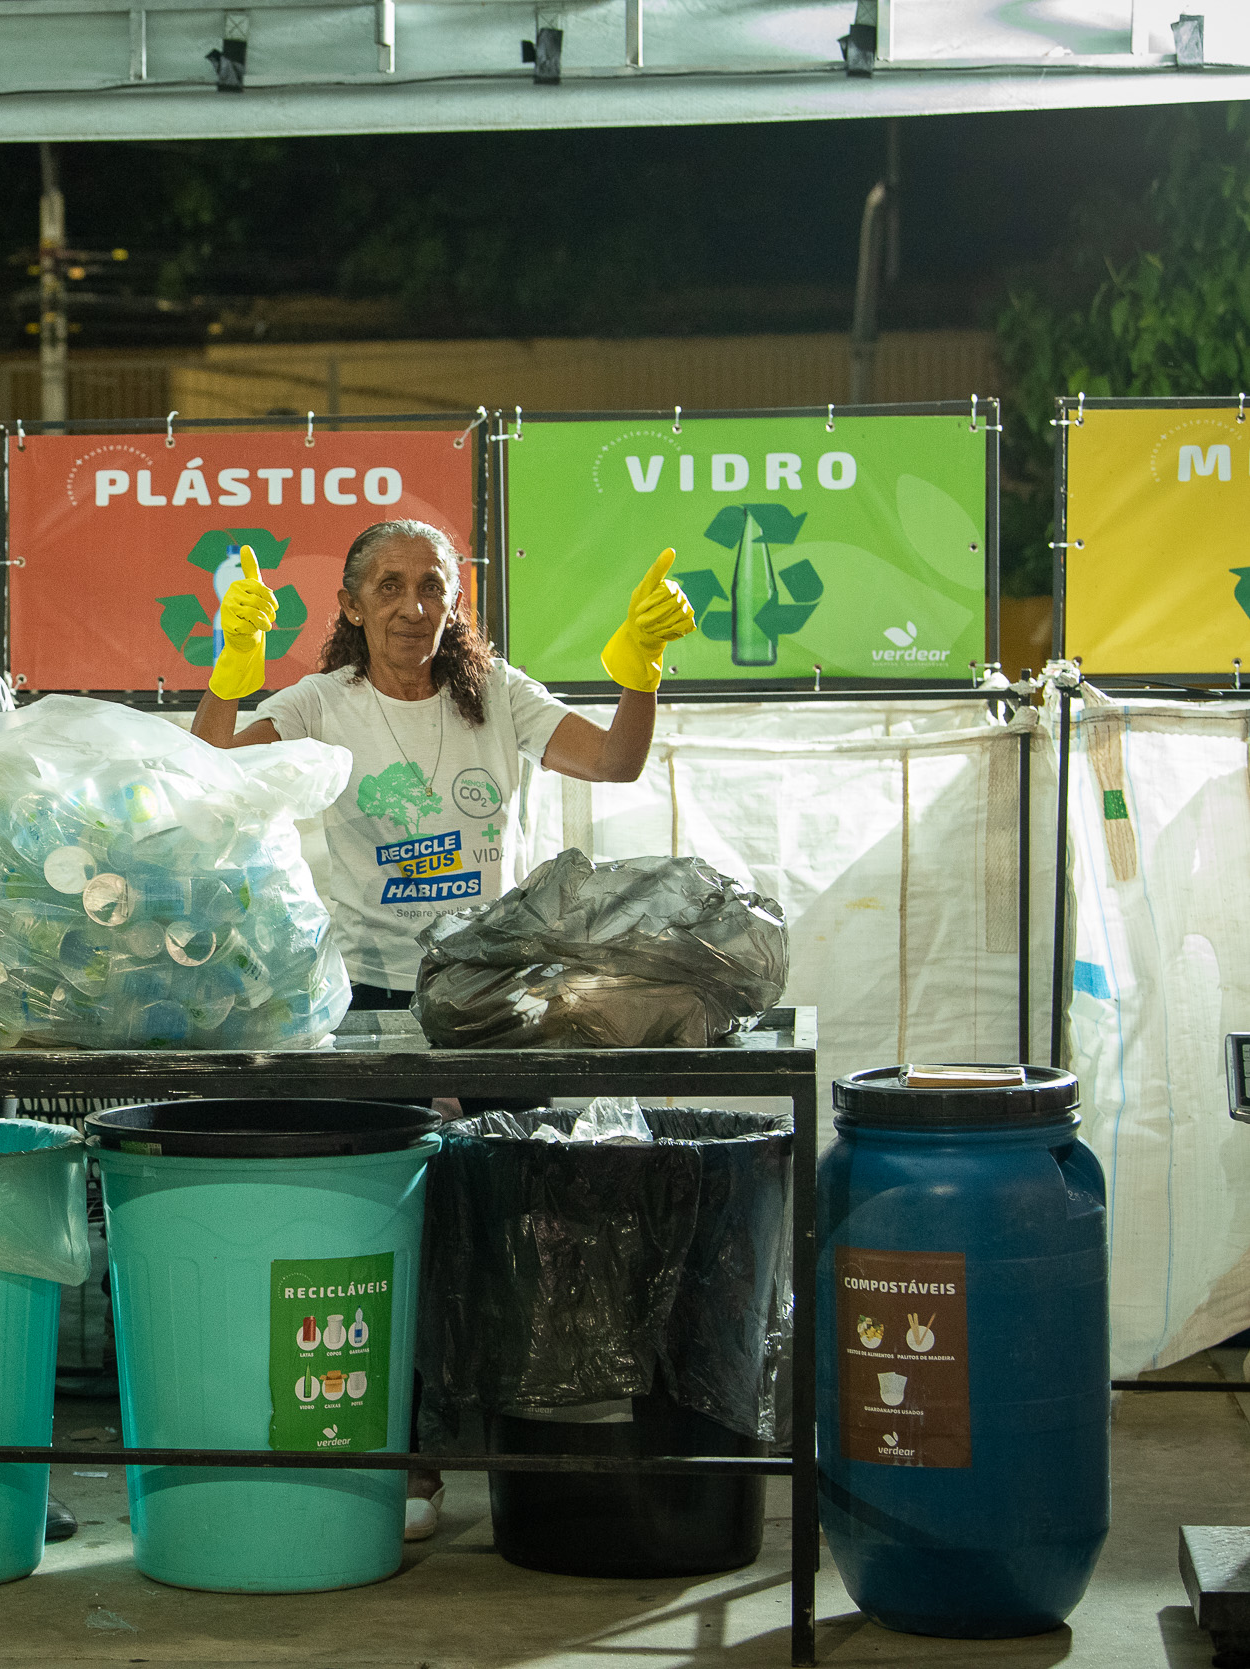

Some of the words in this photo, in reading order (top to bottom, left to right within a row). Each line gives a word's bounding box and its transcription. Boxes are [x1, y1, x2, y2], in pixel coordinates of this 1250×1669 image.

[625, 451, 857, 493] VIDRO
[1177, 444, 1250, 482] M
[95, 456, 403, 507] PLÁSTICO
[872, 646, 950, 661] verdear
[461, 779, 485, 788] MENOS
[381, 835, 456, 862] RECICLE
[403, 851, 455, 878] SEUS
[386, 879, 480, 898] HÁBITOS
[396, 908, 432, 919] Separe
[284, 1280, 388, 1299] RECICLÁVEIS
[844, 1276, 956, 1295] COMPOSTÁVEIS
[316, 1438, 351, 1447] verdear
[877, 1446, 916, 1456] verdear
